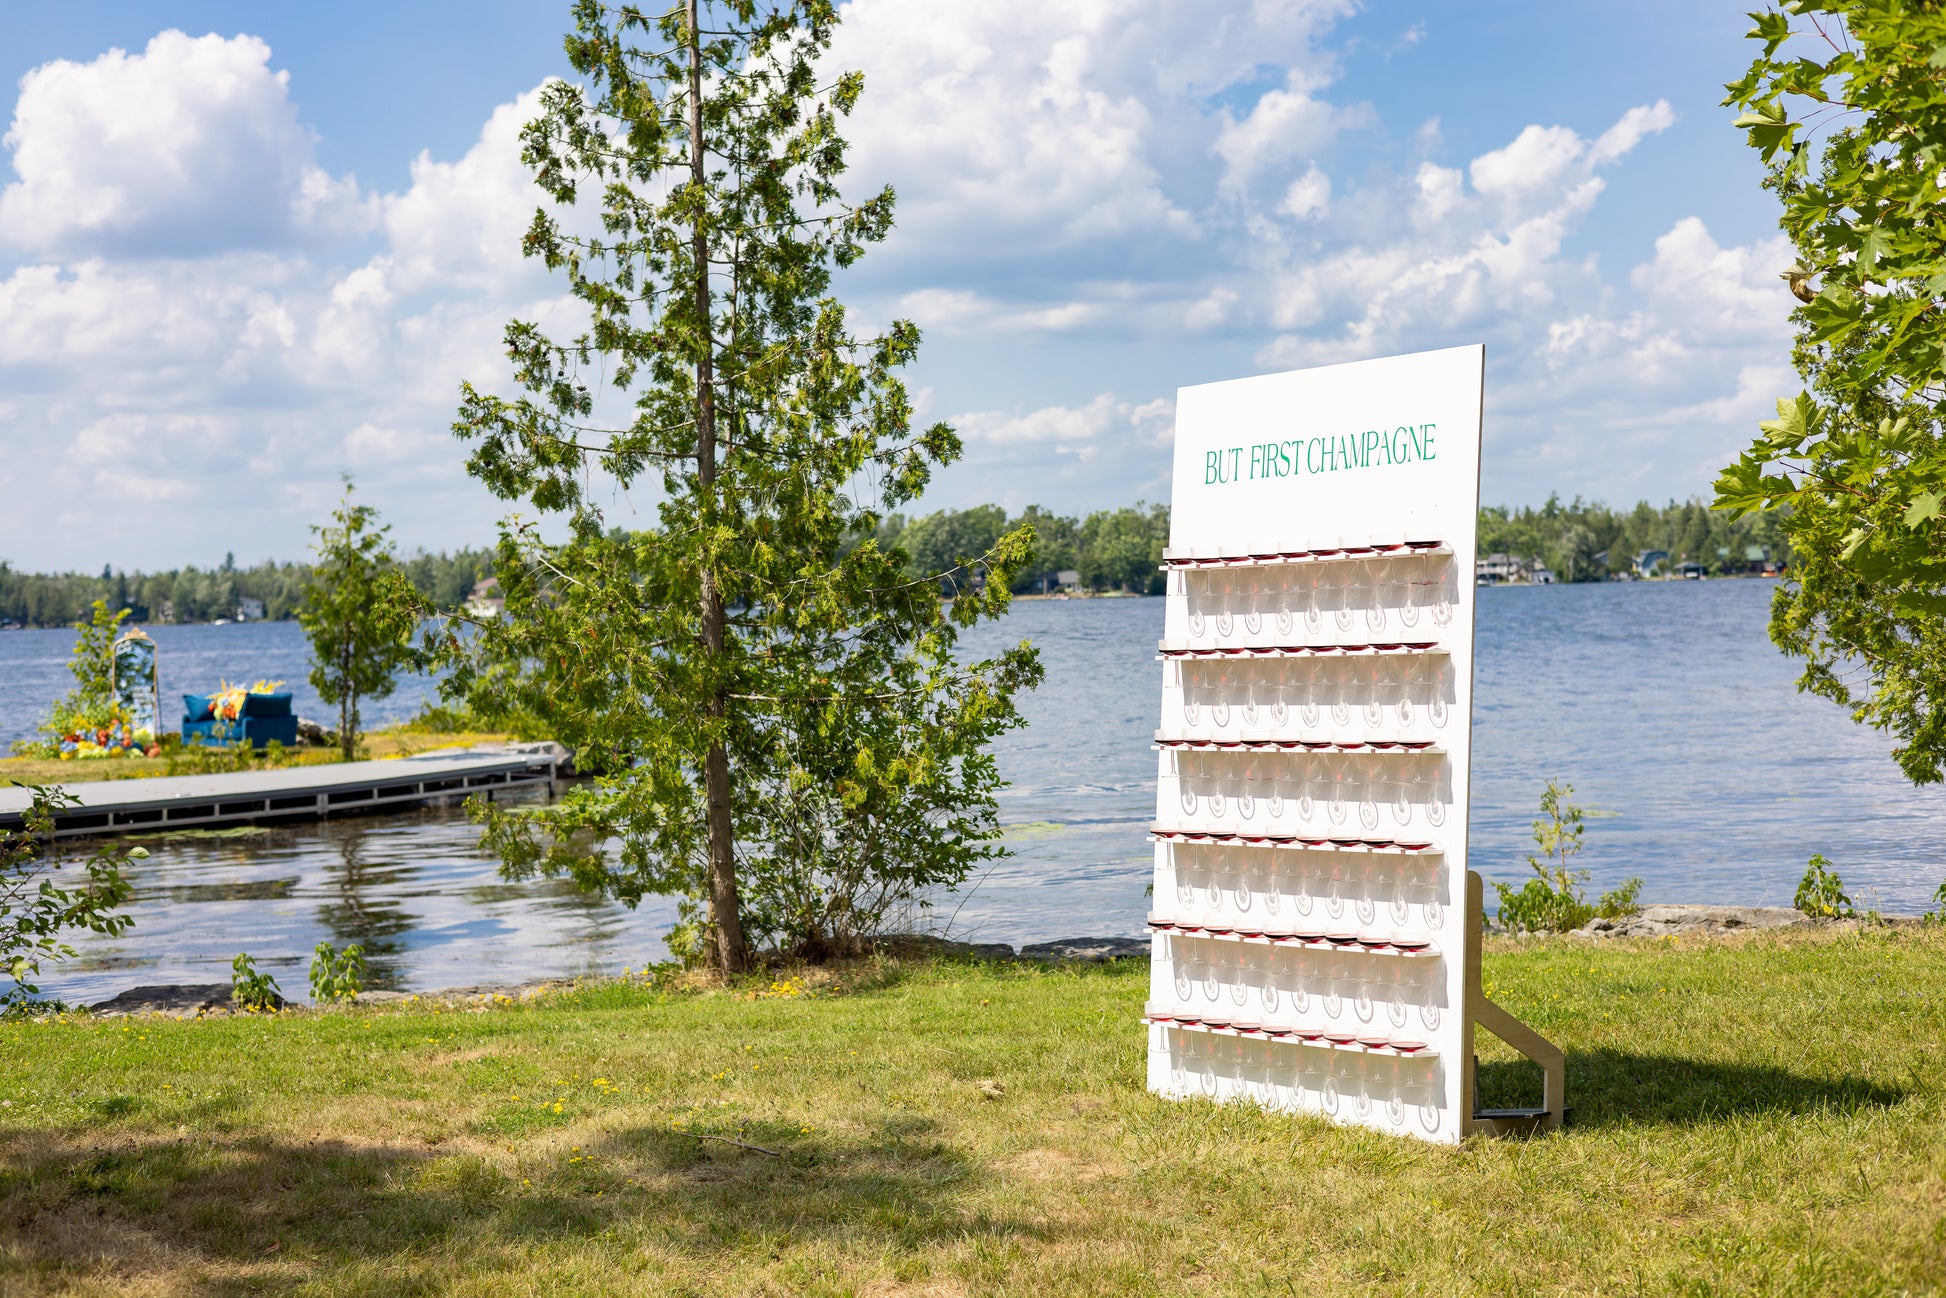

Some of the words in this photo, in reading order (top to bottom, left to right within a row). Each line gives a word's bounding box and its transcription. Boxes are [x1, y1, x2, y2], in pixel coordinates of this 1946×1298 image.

[1205, 447, 1243, 485] BUT
[1250, 439, 1304, 479] FIRST
[1307, 423, 1437, 474] CHAMPAGNE
